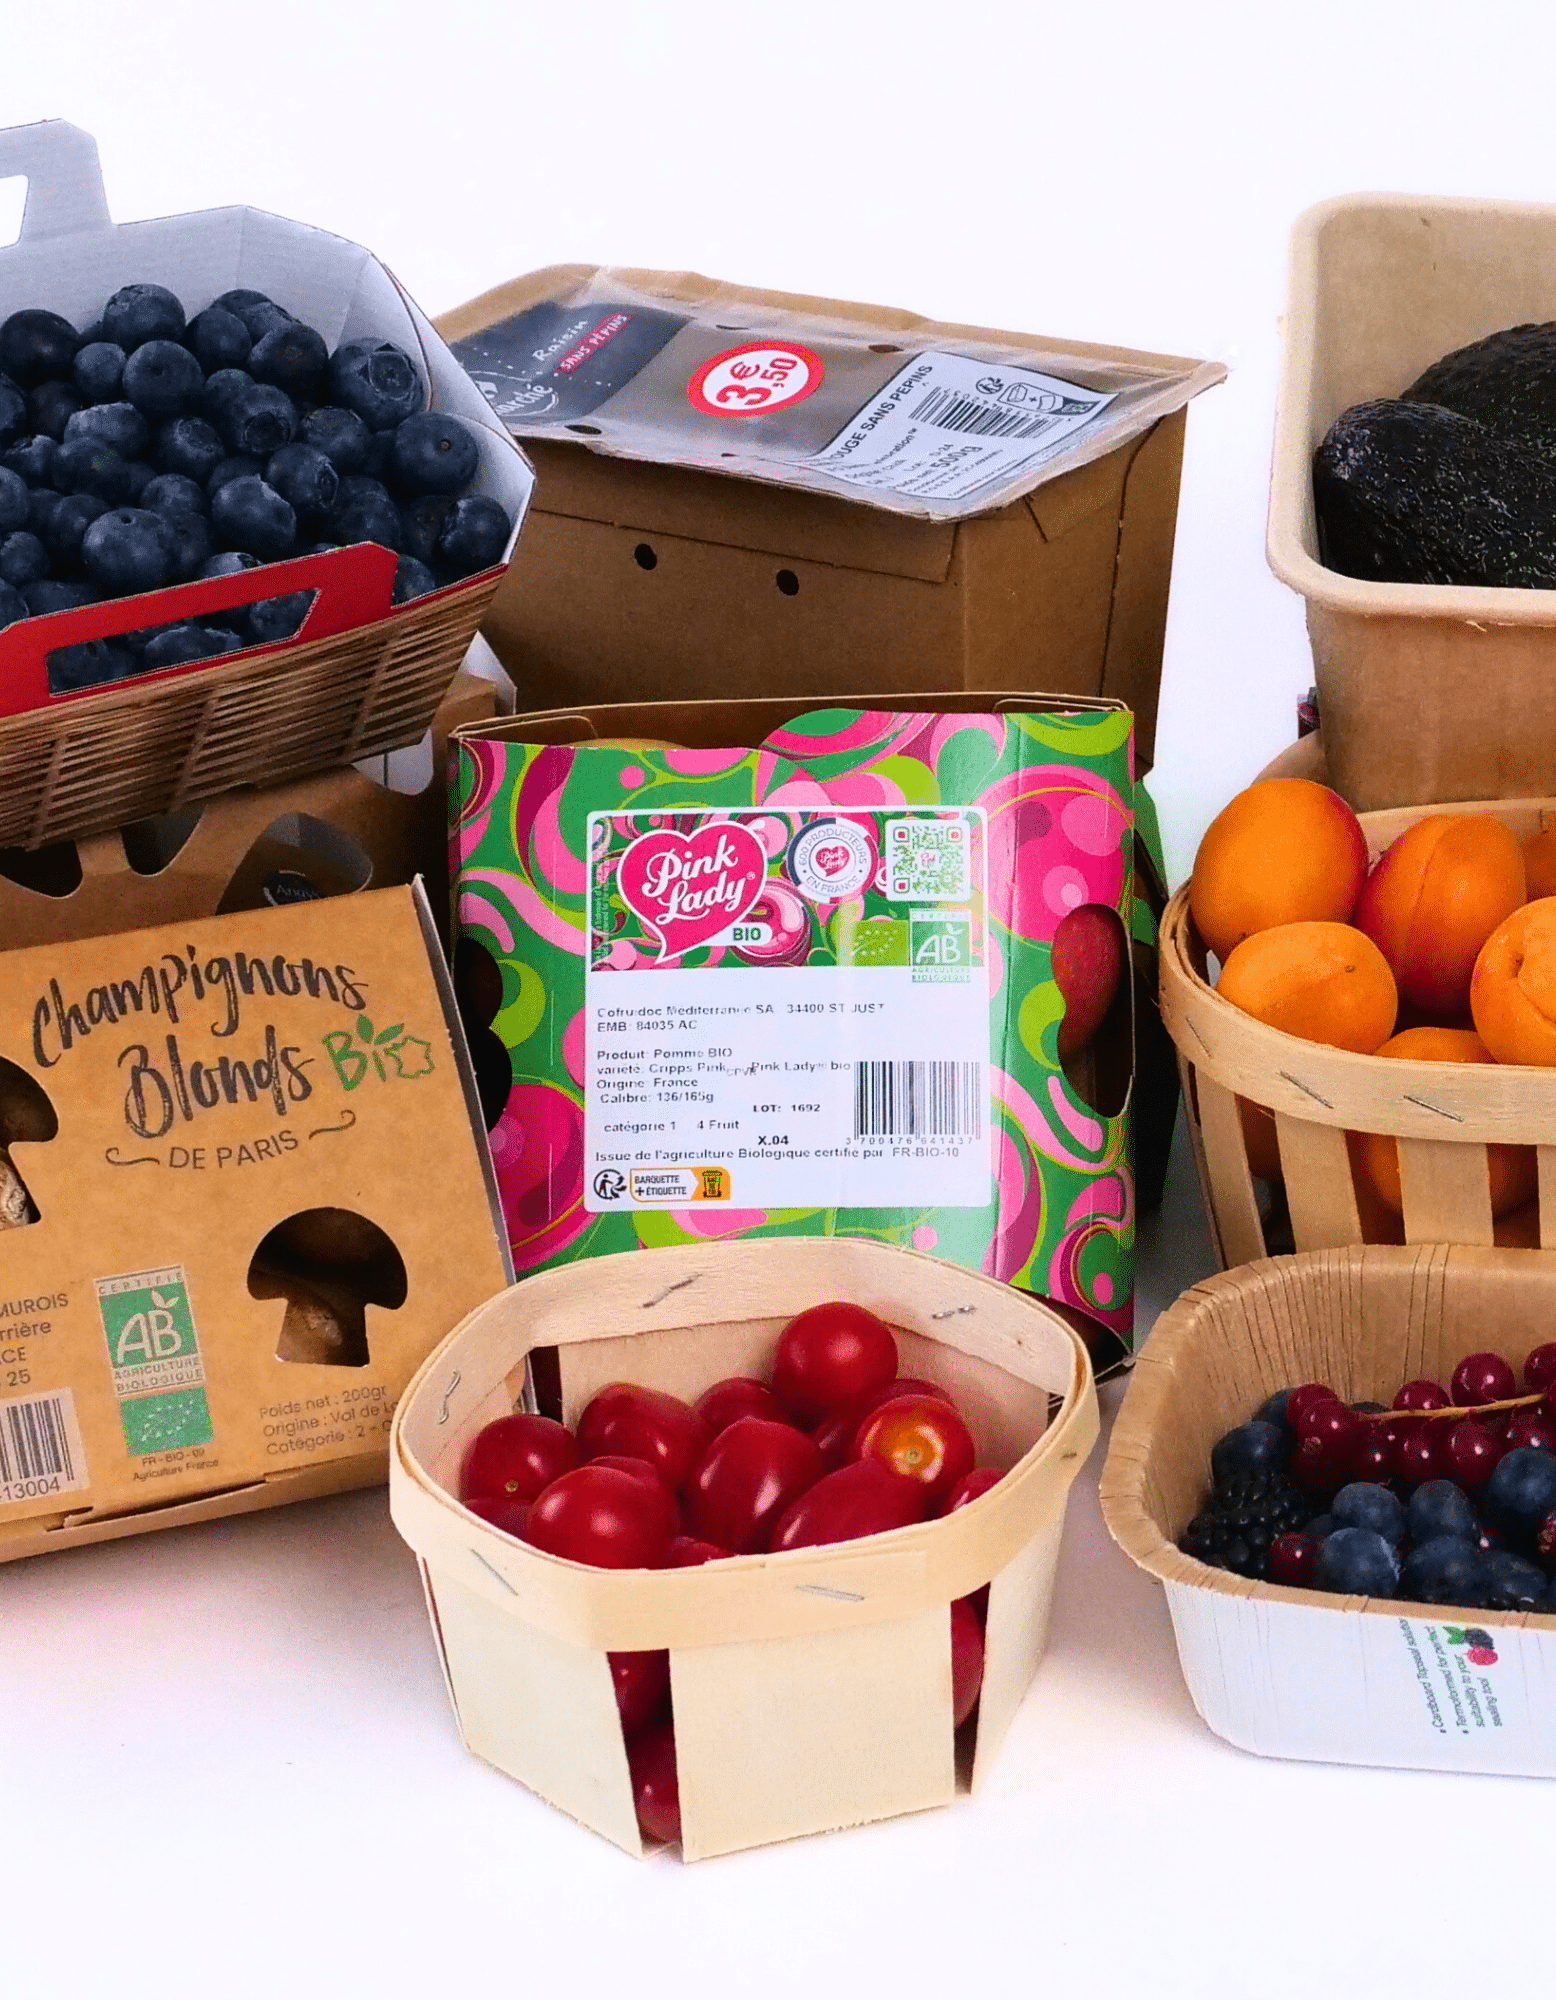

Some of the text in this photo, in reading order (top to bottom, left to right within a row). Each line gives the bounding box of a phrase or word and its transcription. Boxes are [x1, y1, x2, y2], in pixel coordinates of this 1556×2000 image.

[532, 320, 588, 361] Raisin
[560, 345, 590, 370] SANS
[495, 384, 554, 414] arché
[824, 364, 933, 460] OUGE SANS PEPINS
[798, 827, 867, 866] 600 PRODUCTEURS
[641, 833, 739, 898] Pink
[805, 875, 861, 894] EN FRANCE
[732, 927, 762, 941] BIO
[915, 934, 961, 963] AB
[32, 944, 369, 1068] Champignons
[755, 1004, 774, 1014] SA
[829, 1003, 845, 1013] ST
[851, 1003, 885, 1013] JUST
[636, 1020, 675, 1031] 84035
[679, 1019, 698, 1030] AC
[654, 1048, 705, 1059] Pomme
[708, 1048, 733, 1058] BIO
[649, 1063, 693, 1075] Cripps
[697, 1062, 726, 1072] Pink
[830, 1060, 851, 1071] bio
[117, 1024, 315, 1138] Blonds
[653, 1077, 699, 1088] France
[753, 1104, 821, 1113] LOT: 1692
[604, 1121, 666, 1134] catégorie
[697, 1120, 740, 1130] 4 Fruit
[168, 1129, 299, 1170] DE PARIS
[758, 1135, 790, 1145] X.04
[596, 1151, 631, 1162] Issue
[635, 1150, 652, 1161] de
[738, 1149, 811, 1161] Biologique
[863, 1149, 883, 1160] par
[892, 1147, 960, 1157] FR-BIO-10
[634, 1175, 680, 1184] BARQUETTE
[117, 1309, 182, 1364] AB
[0, 1346, 27, 1365] CE
[114, 1355, 201, 1379] AGRICULTURE
[7, 1368, 31, 1387] 25
[116, 1369, 204, 1392] BIOLOGIQUE
[259, 1401, 301, 1418] Poids
[342, 1385, 387, 1403] 200gr
[330, 1408, 356, 1423] Val
[360, 1405, 380, 1418] de
[355, 1424, 366, 1437] 2
[185, 1459, 219, 1470] France
[0, 1476, 61, 1500] 13004
